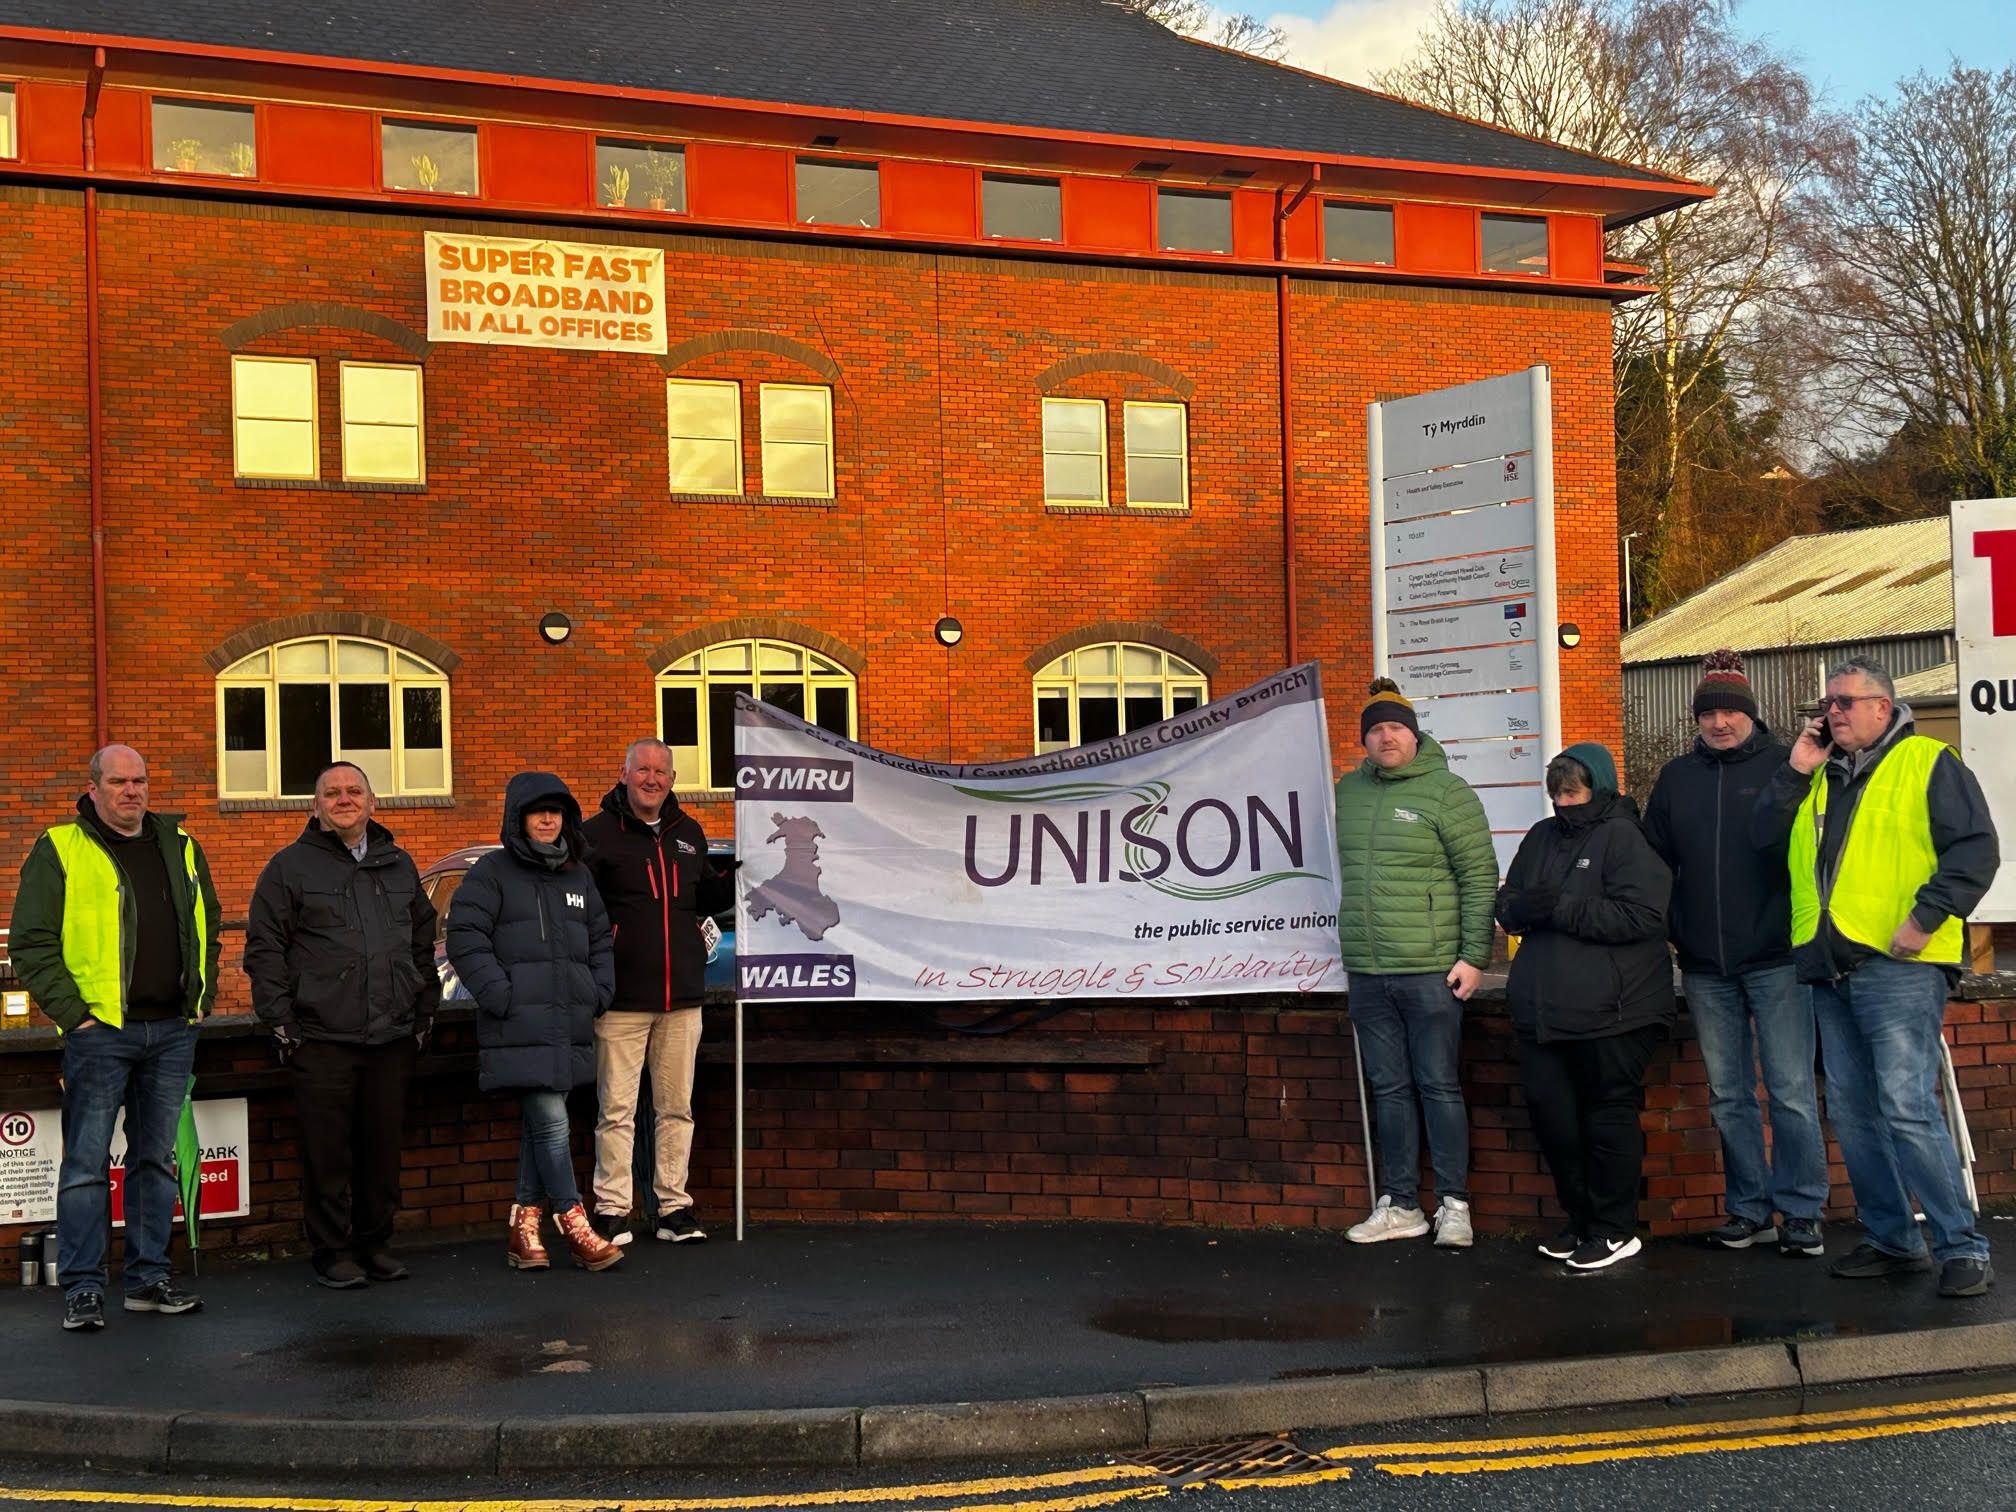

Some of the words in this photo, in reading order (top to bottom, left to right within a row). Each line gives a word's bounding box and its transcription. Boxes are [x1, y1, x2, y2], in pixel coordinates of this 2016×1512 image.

[438, 244, 556, 278] SUPER
[564, 253, 652, 284] FAST
[439, 278, 654, 316] BROADBAND
[442, 310, 472, 332] IN
[478, 312, 533, 336] ALL
[539, 315, 653, 343] OFFICES
[1503, 473, 1519, 482] HSE
[972, 735, 1153, 778] Carmarthenshire
[1156, 706, 1231, 745] County
[1236, 672, 1308, 710] Branch
[736, 766, 852, 792] CYMRU
[964, 791, 1304, 887] UNISON
[566, 892, 584, 909] HH
[1134, 922, 1164, 940] the
[1168, 918, 1221, 941] public
[1224, 915, 1285, 934] service
[1290, 912, 1338, 930] union
[741, 964, 850, 988] WALES
[956, 960, 1117, 995] Struggle
[1154, 950, 1334, 993] Solidarity
[5, 1120, 29, 1136] 10
[0, 1148, 36, 1158] NOTICE
